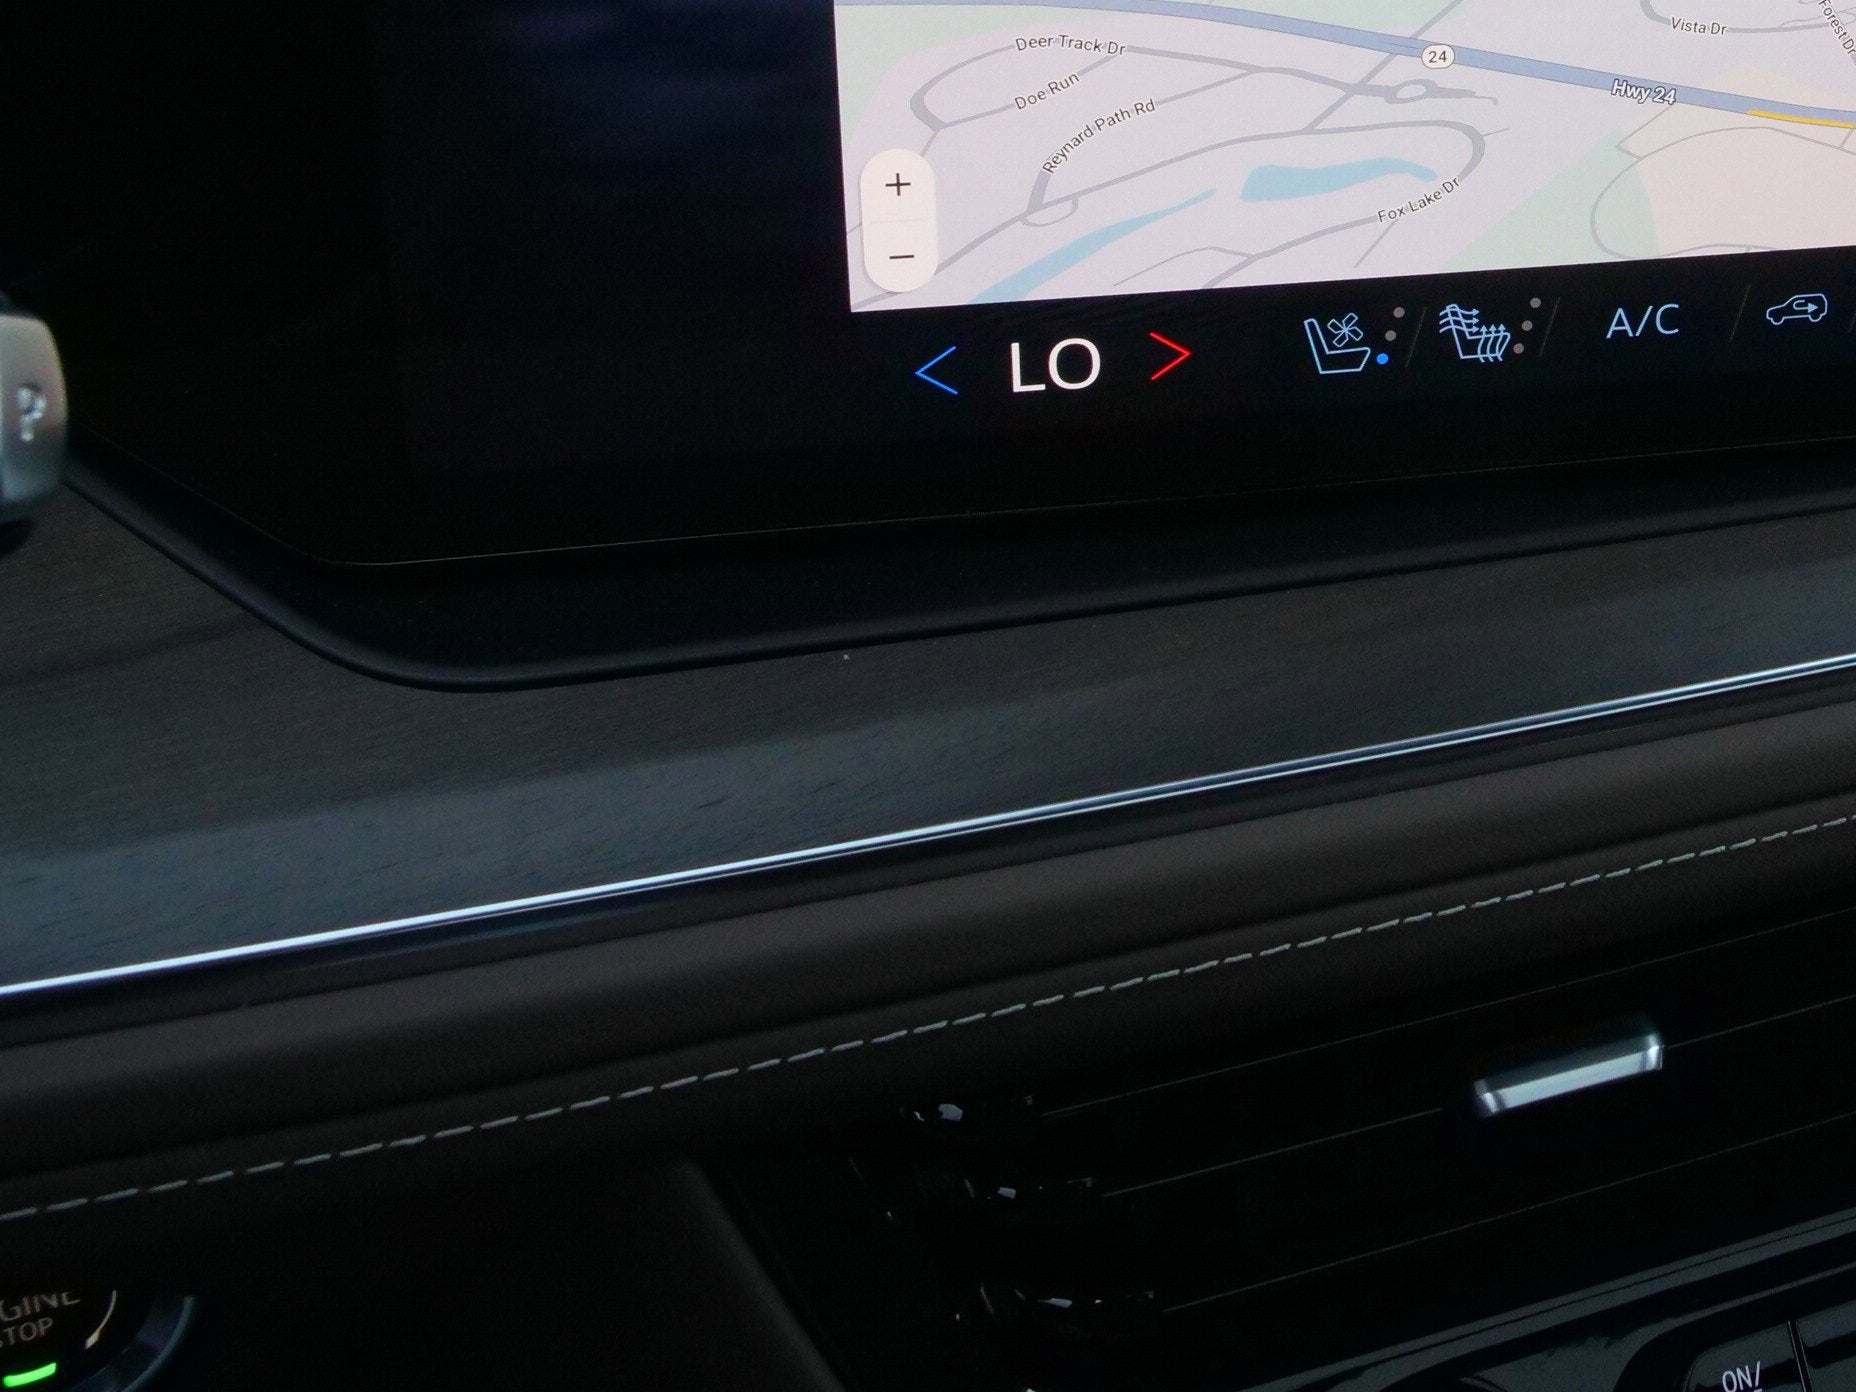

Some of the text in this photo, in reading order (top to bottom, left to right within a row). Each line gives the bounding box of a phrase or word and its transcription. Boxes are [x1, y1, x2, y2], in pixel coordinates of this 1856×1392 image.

[1671, 16, 1727, 35] Vista Dr
[1015, 34, 1126, 56] Deer Track Dr
[1428, 50, 1448, 63] 24
[1842, 36, 1856, 55] Dr
[1014, 73, 1080, 110] Doe Run
[1611, 79, 1677, 106] Hwy 24
[1042, 98, 1156, 174] Reynard Path Rd
[1376, 177, 1461, 224] Fox Lake Dr
[1606, 303, 1680, 339] A/C
[1010, 337, 1101, 393] LO
[1721, 1360, 1761, 1392] ON/
